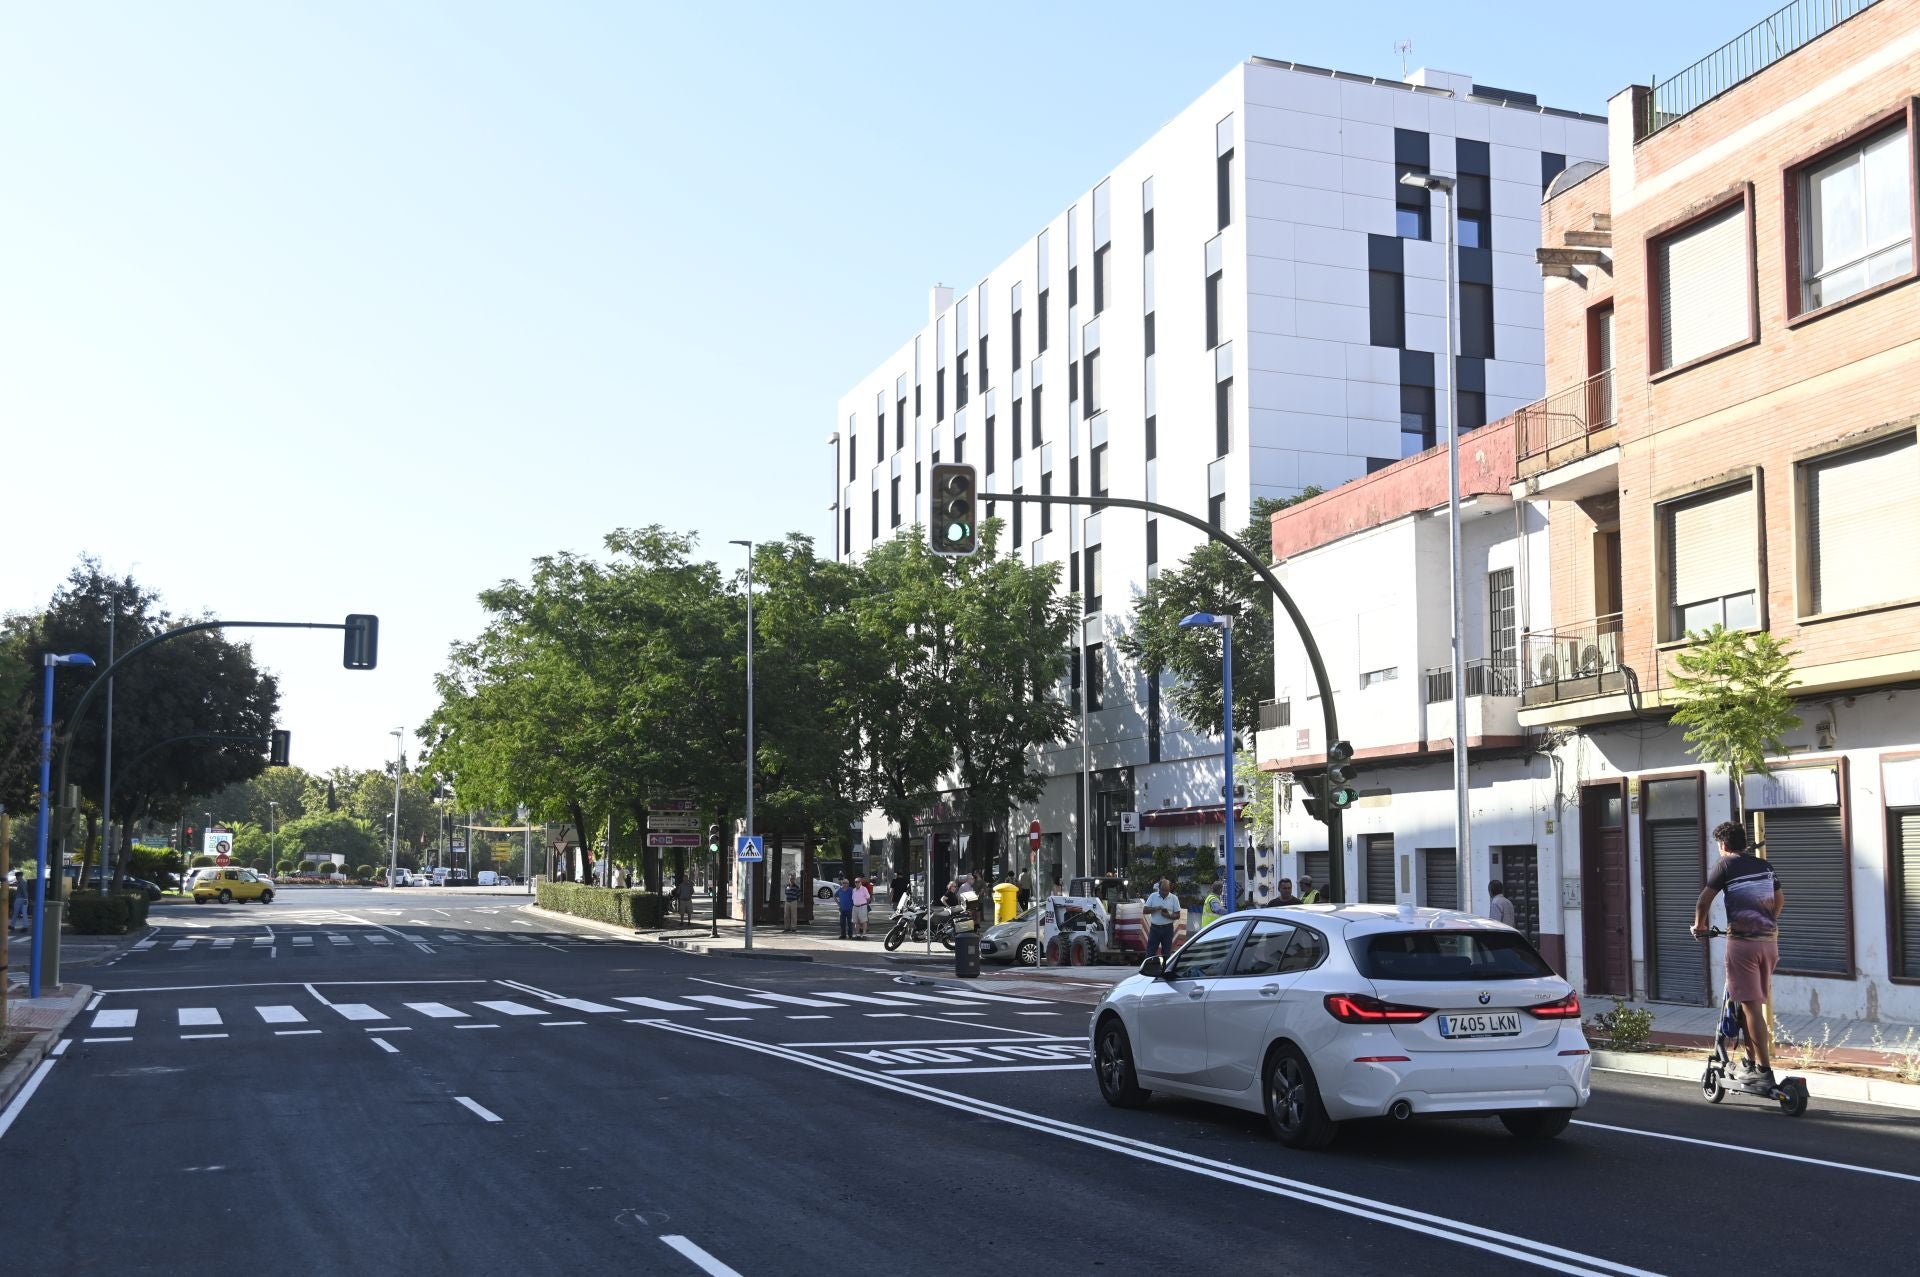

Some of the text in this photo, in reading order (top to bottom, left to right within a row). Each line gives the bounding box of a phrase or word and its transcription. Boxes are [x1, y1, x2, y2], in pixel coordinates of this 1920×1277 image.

[1450, 1015, 1517, 1033] 7405 LKN
[835, 1045, 1090, 1064] MOTOS
